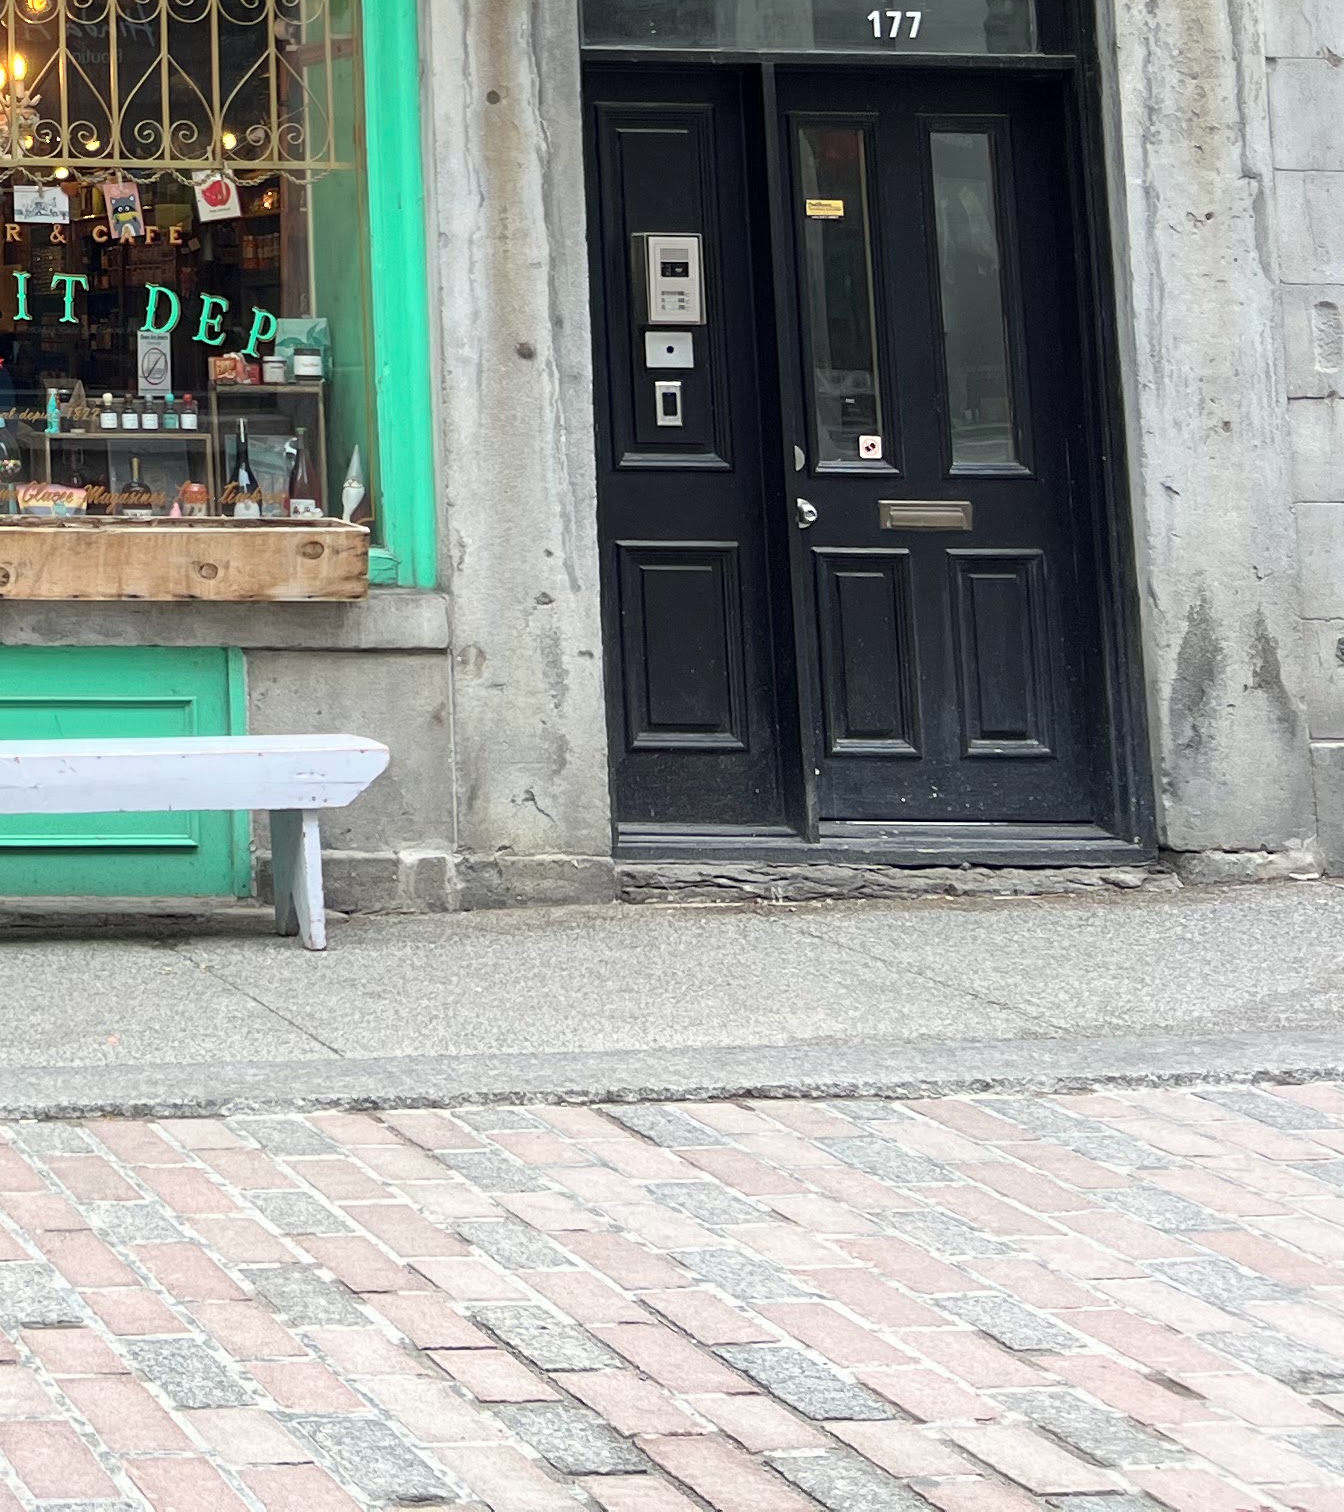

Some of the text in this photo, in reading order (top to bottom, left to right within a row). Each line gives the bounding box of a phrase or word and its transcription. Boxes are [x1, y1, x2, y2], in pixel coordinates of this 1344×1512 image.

[866, 9, 923, 39] 177
[49, 223, 66, 244] &
[92, 221, 184, 245] CAFÉ
[140, 281, 280, 359] DEP
[66, 405, 101, 422] 1822
